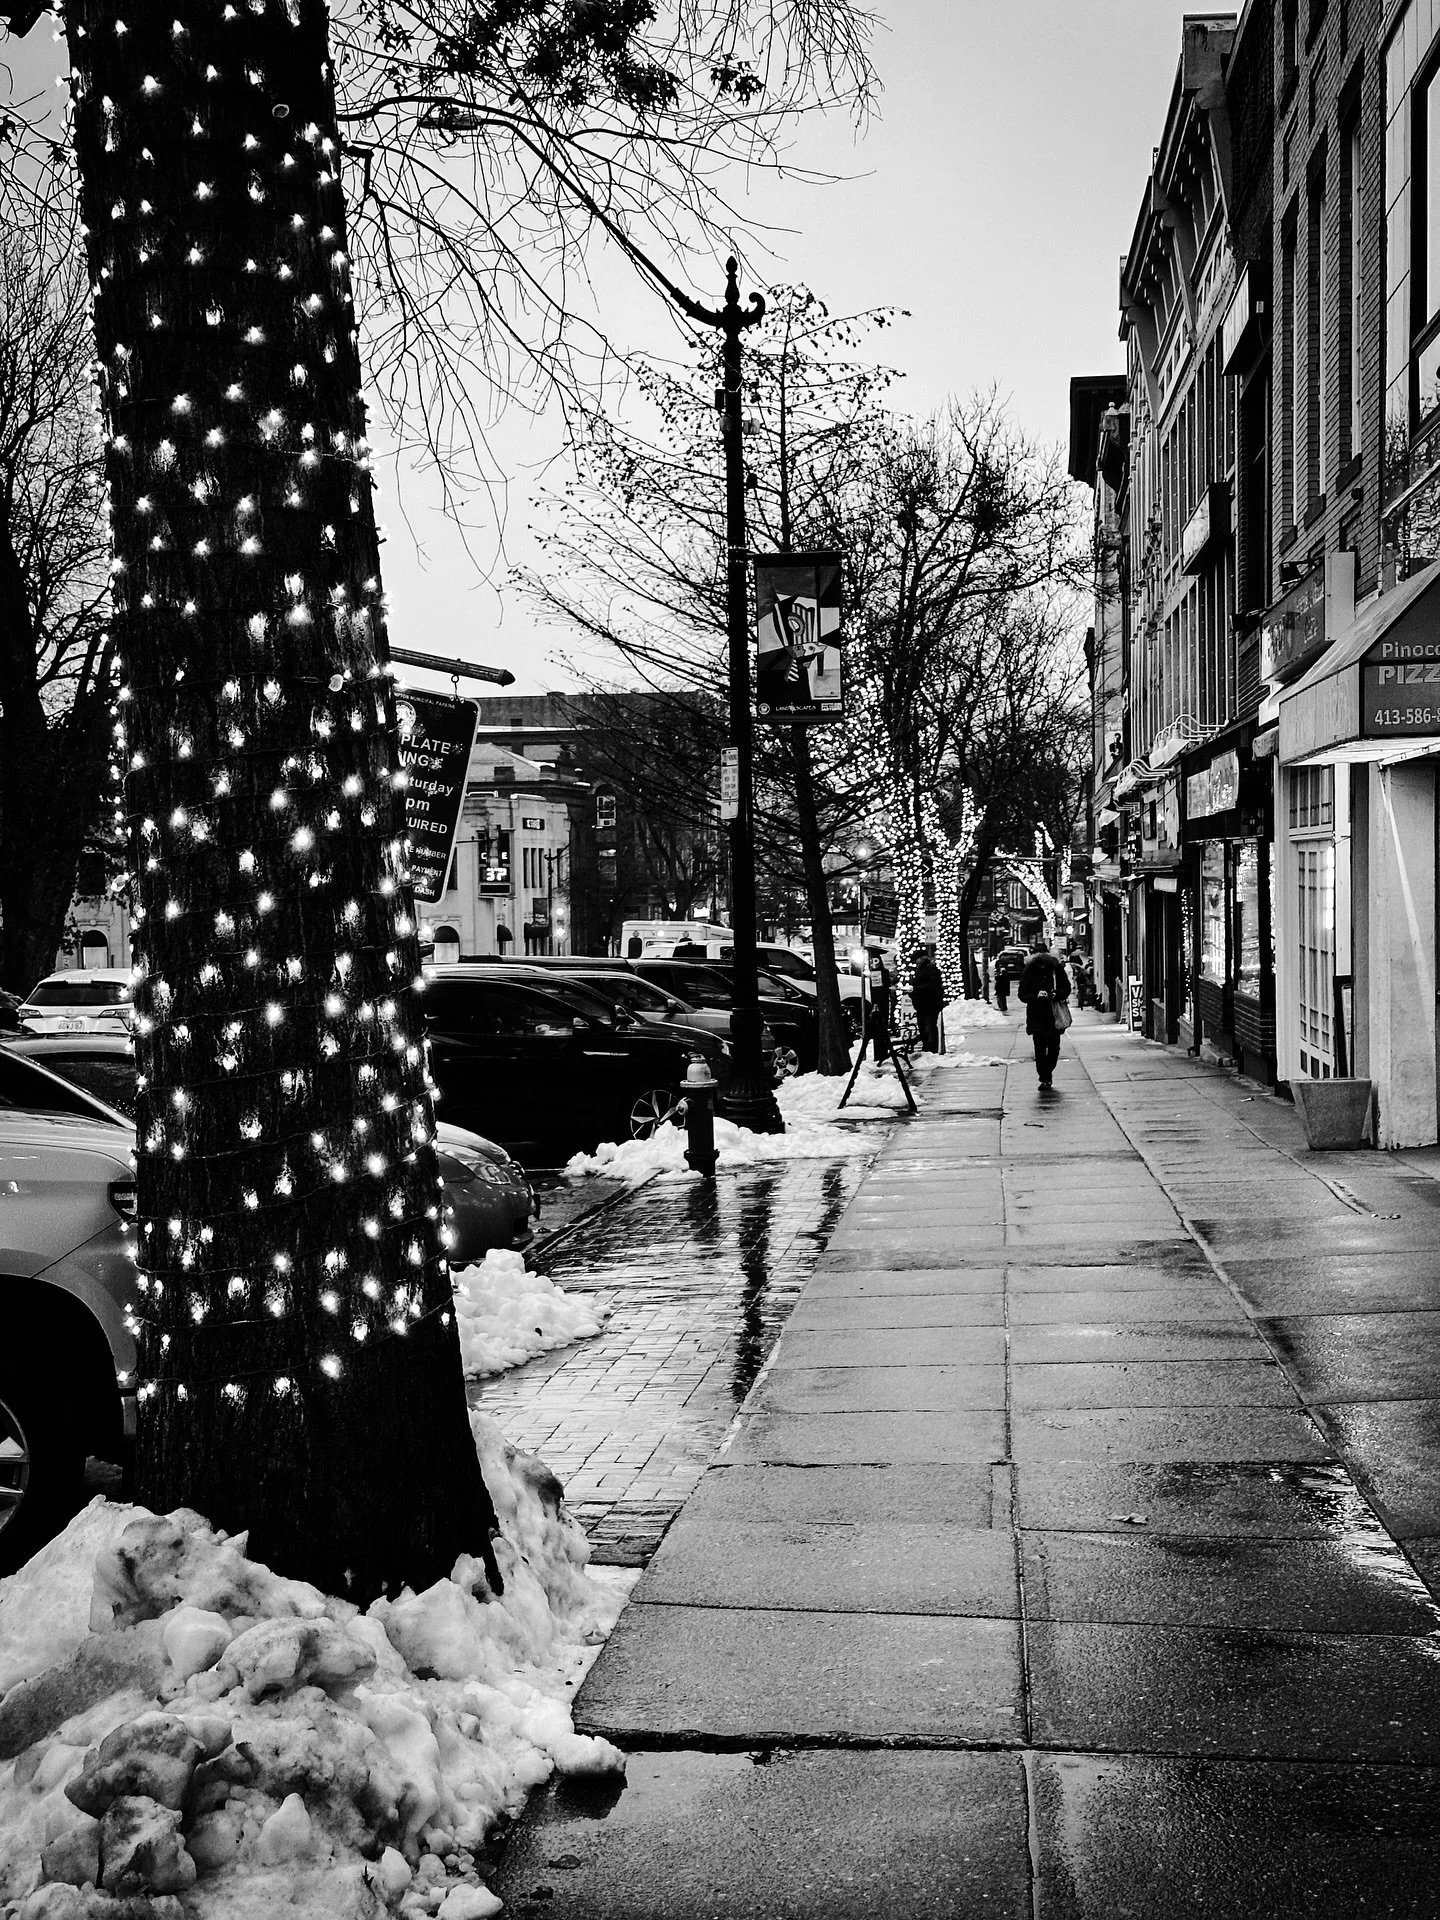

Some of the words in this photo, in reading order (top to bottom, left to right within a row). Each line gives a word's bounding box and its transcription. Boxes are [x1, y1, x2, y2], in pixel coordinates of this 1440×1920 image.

[1378, 664, 1440, 685] PIZZ
[400, 733, 451, 755] PLATE
[405, 798, 430, 811] pm
[406, 817, 448, 834] UIRED
[415, 847, 446, 860] NUMBER
[411, 864, 443, 878] PAYMENT
[413, 886, 435, 897] DASH
